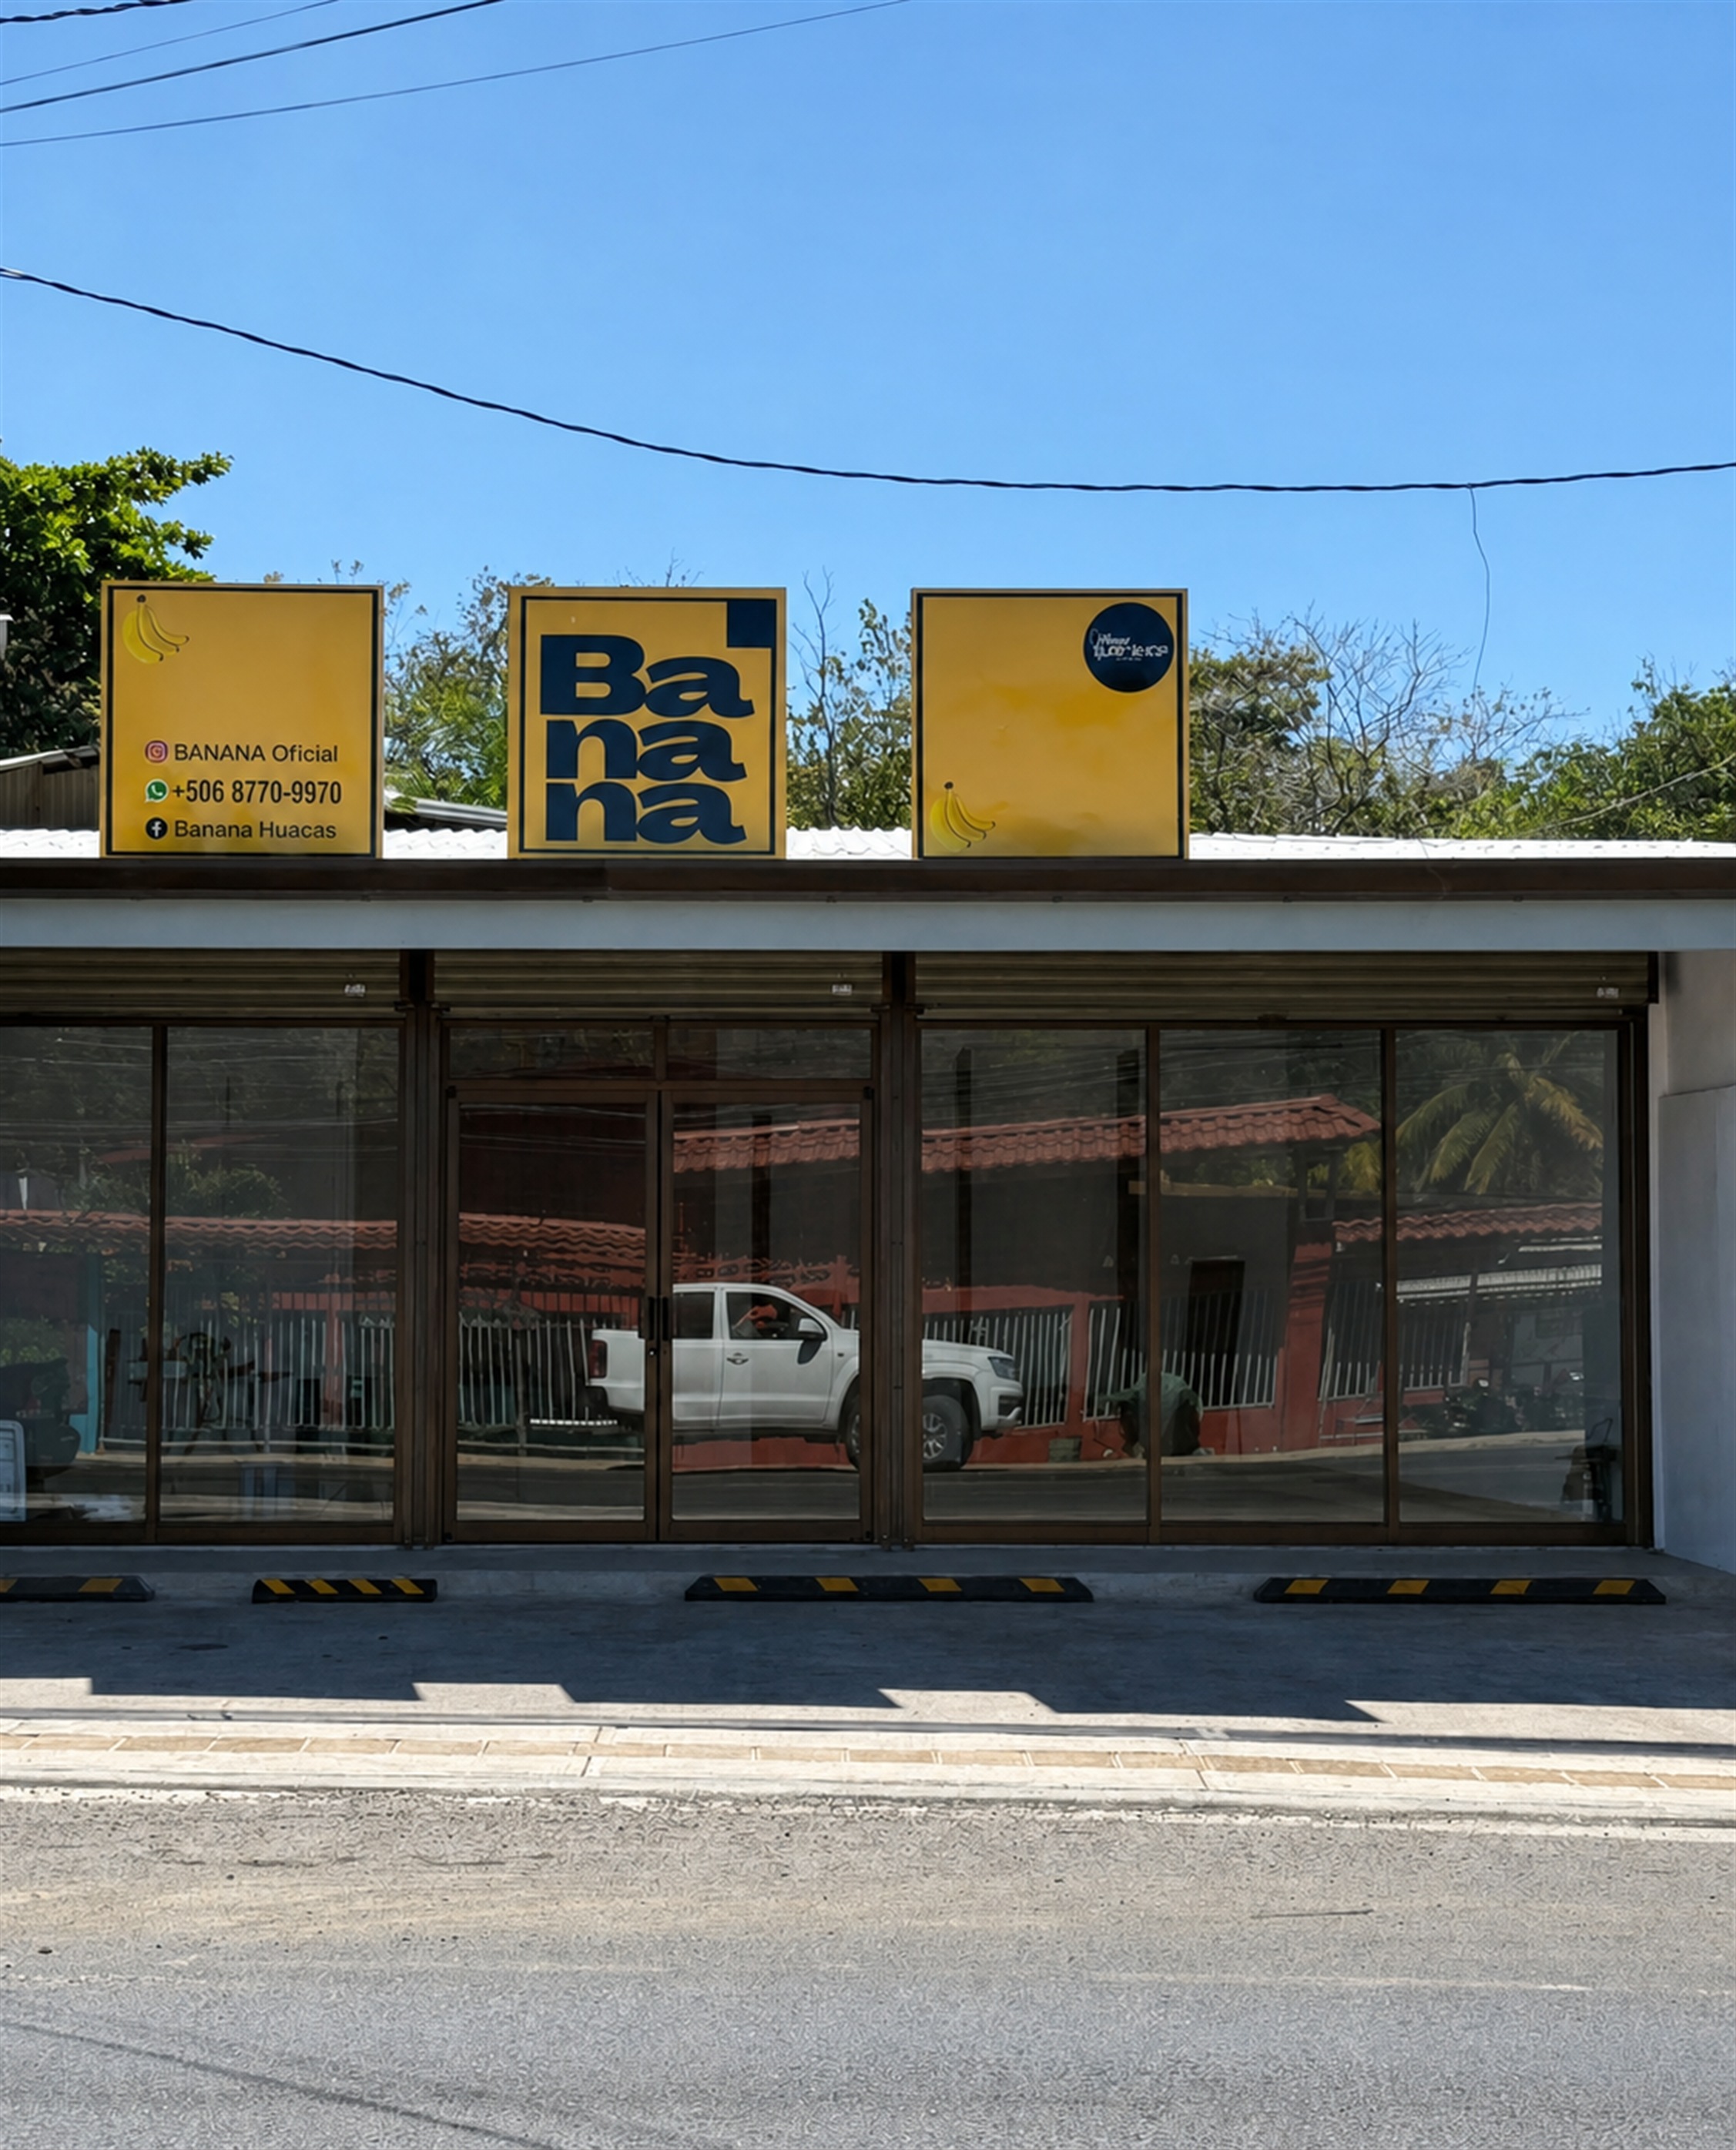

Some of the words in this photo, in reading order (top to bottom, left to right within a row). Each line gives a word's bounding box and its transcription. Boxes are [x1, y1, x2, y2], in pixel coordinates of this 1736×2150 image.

[174, 744, 266, 762] BANANA
[272, 745, 338, 762] Oficial
[546, 718, 747, 782] na
[172, 779, 224, 802] +506
[232, 780, 341, 804] 8770-9970
[545, 781, 747, 845] na
[174, 820, 253, 838] Banana
[260, 821, 337, 839] Huacas
